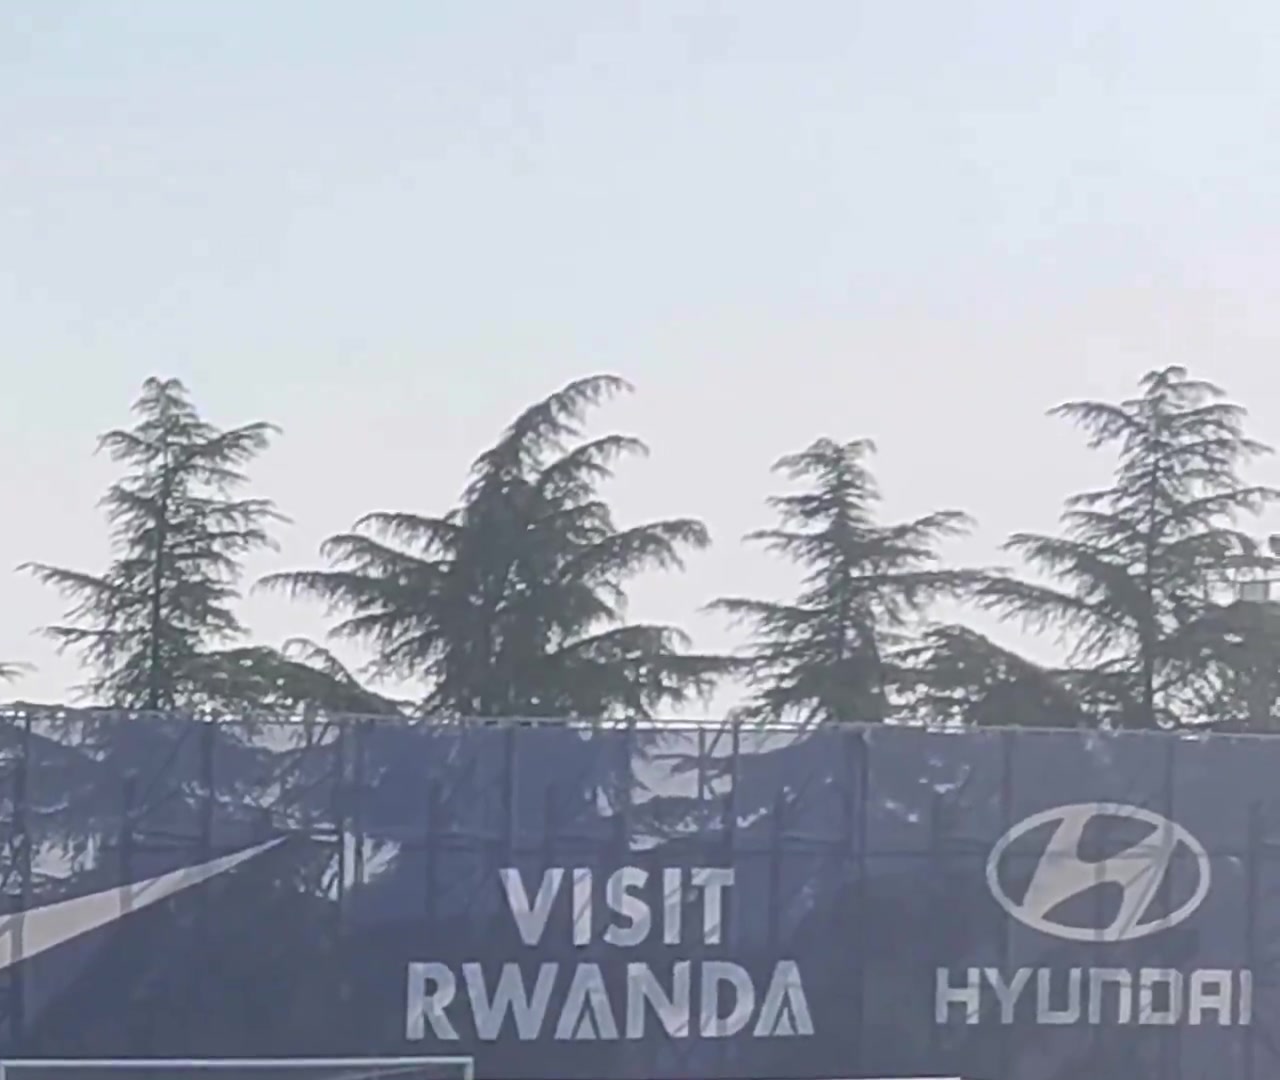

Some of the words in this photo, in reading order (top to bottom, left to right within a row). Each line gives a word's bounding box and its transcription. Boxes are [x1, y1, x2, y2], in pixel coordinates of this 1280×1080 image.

[499, 866, 736, 947] VISIT
[405, 959, 815, 1041] RWANDA
[935, 967, 1253, 1026] HYUNDAI
